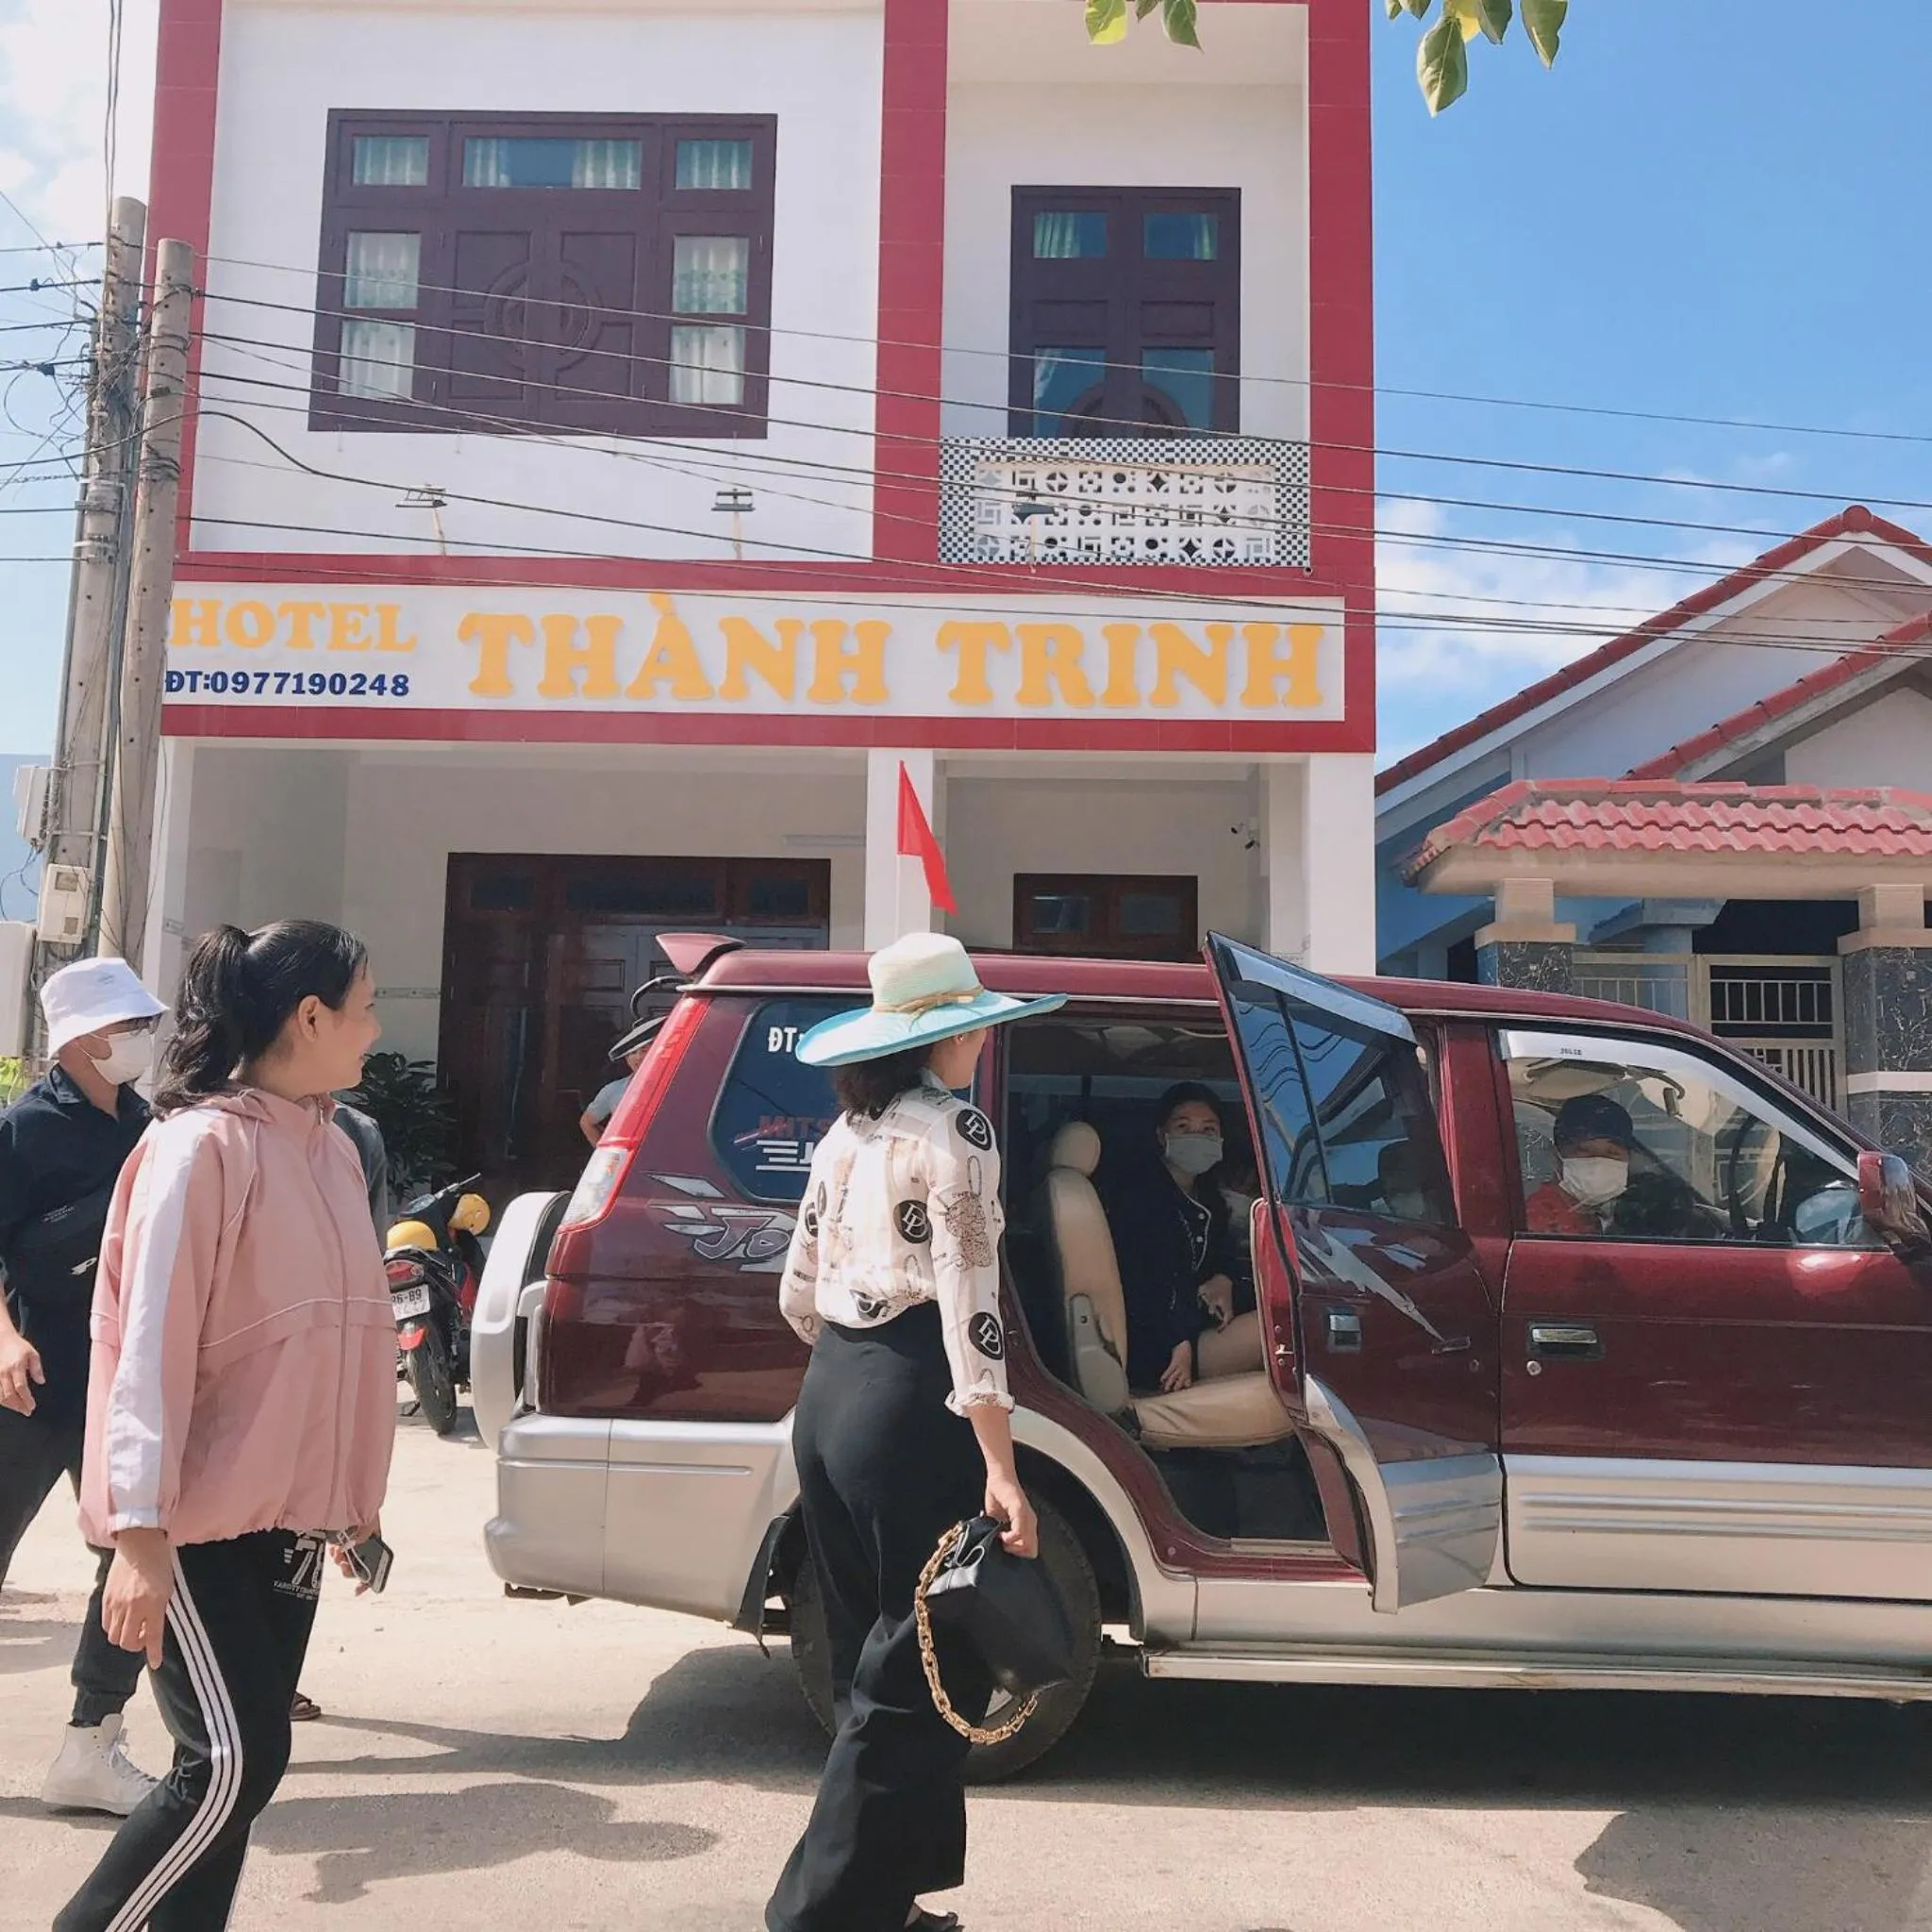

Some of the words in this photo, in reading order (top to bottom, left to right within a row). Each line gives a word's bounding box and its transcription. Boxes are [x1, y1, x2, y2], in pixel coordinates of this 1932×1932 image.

[170, 597, 418, 653] HOTEL
[458, 591, 894, 704] THÀNH
[936, 621, 1325, 709] TRINH
[164, 670, 409, 697] ĐT:0977190248
